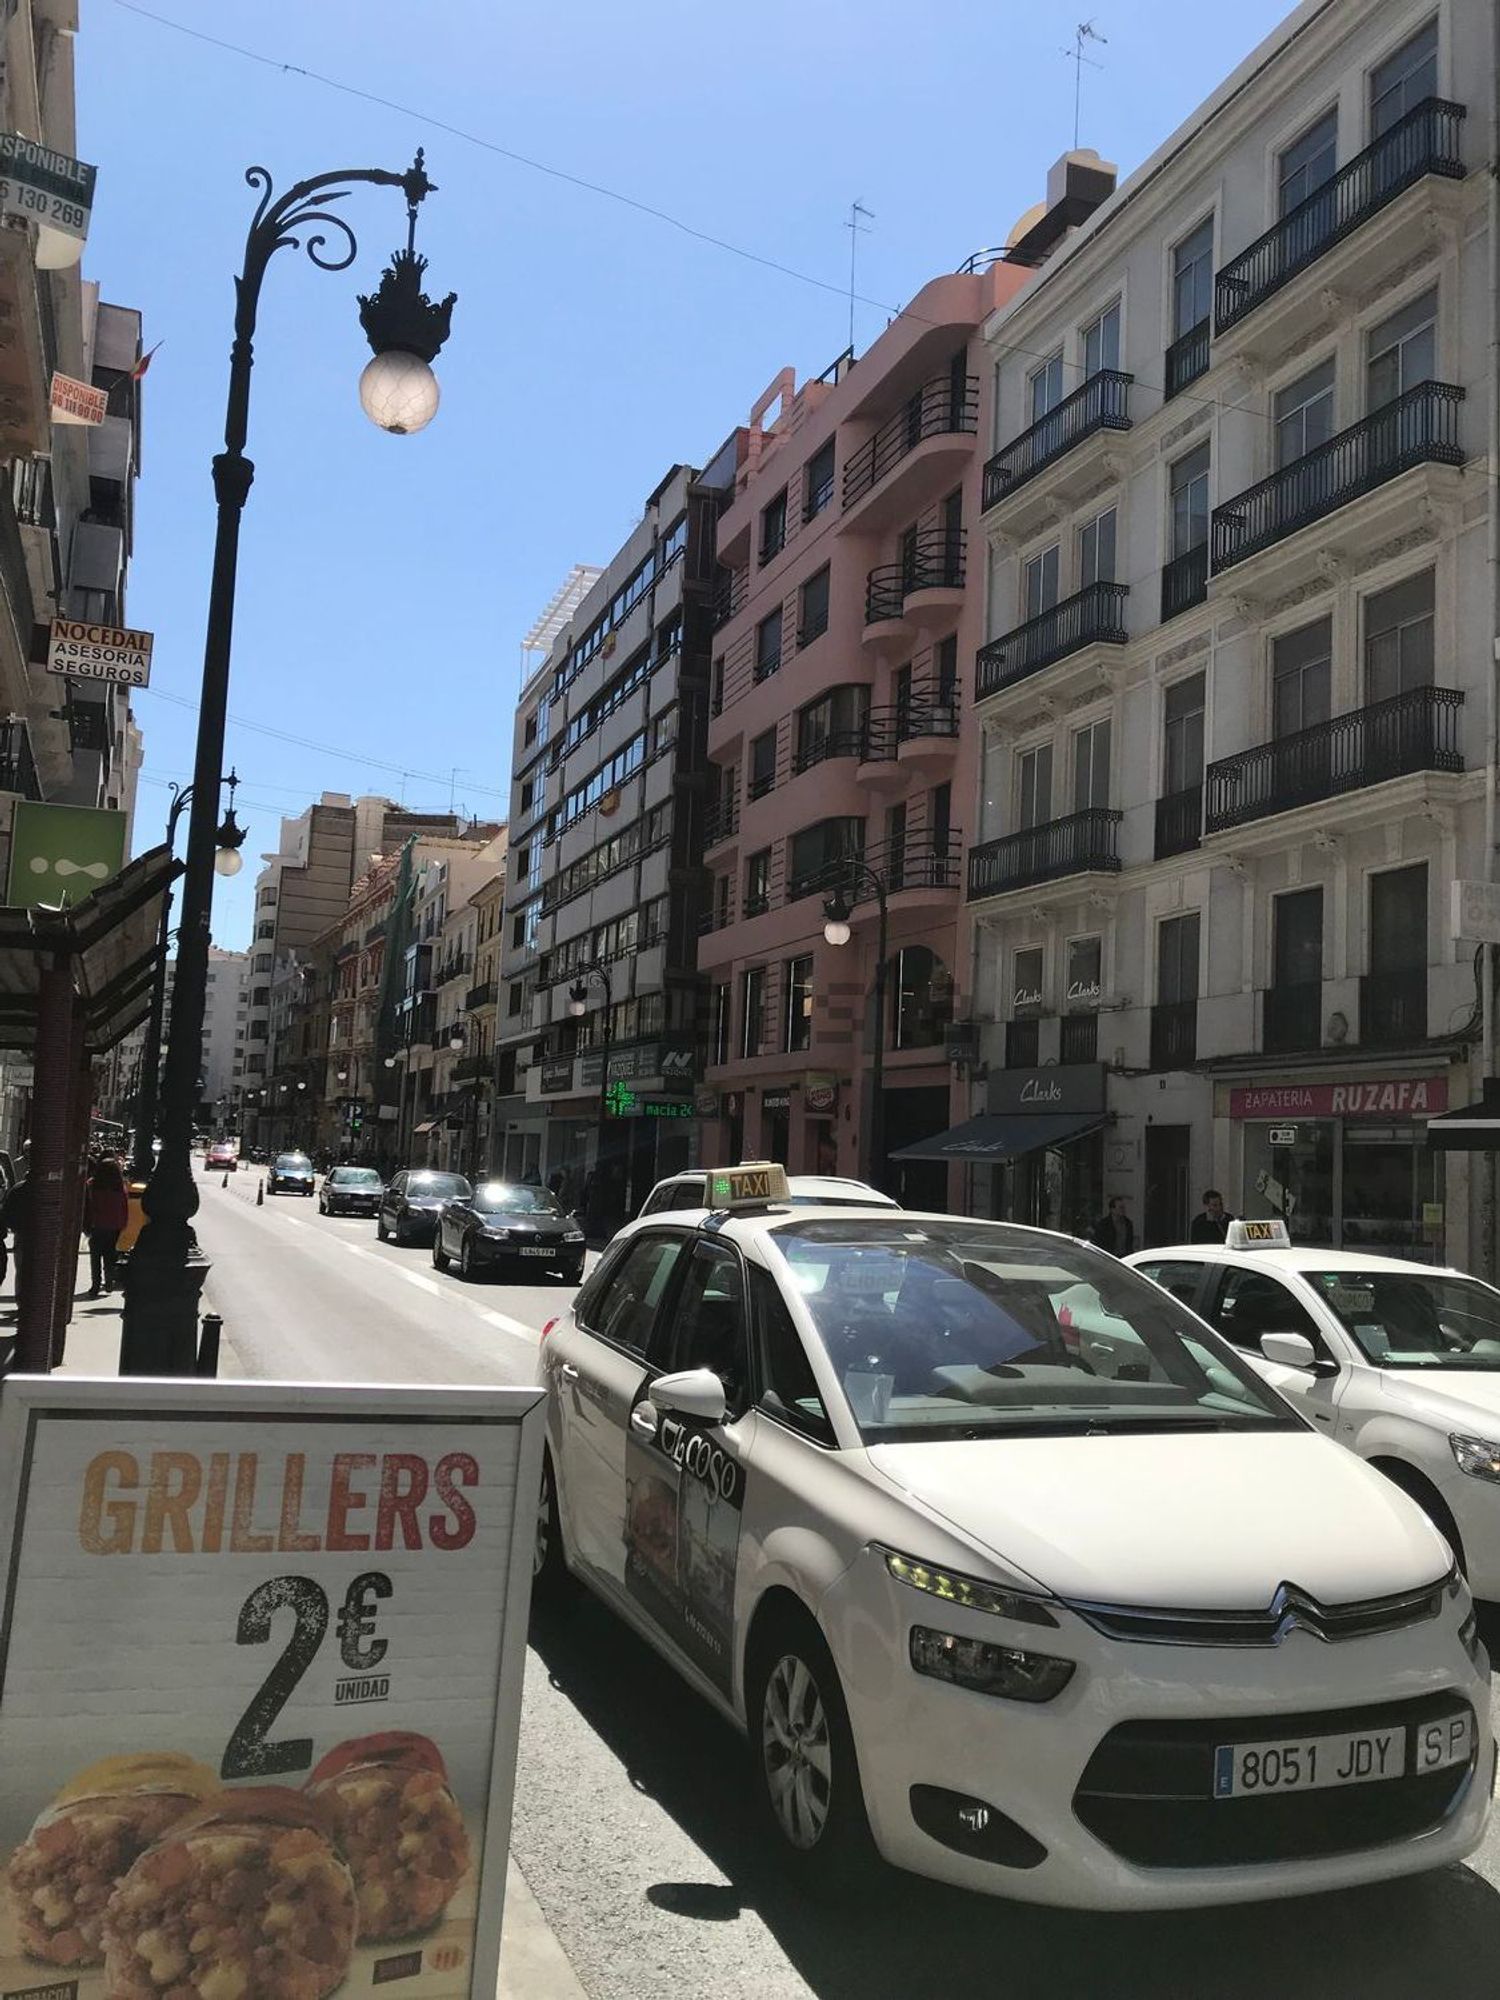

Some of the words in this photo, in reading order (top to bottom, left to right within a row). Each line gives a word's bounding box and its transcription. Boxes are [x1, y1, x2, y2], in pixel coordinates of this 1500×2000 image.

[17, 186, 47, 213] 130
[51, 200, 84, 228] 269
[54, 378, 106, 411] DISPONIBLE
[54, 621, 149, 652] NOCEDAL
[55, 642, 145, 667] ASESORIA
[53, 658, 144, 684] SEGUROS
[1019, 1078, 1062, 1103] Clarks
[1244, 1090, 1313, 1109] ZAPATERIA
[1331, 1082, 1428, 1113] RUZAFA
[730, 1172, 769, 1199] TAXI
[78, 1449, 481, 1556] GRILLERS
[334, 1678, 390, 1702] UNIDAD
[1241, 1746, 1318, 1789] 8051
[1337, 1735, 1393, 1779] JDY
